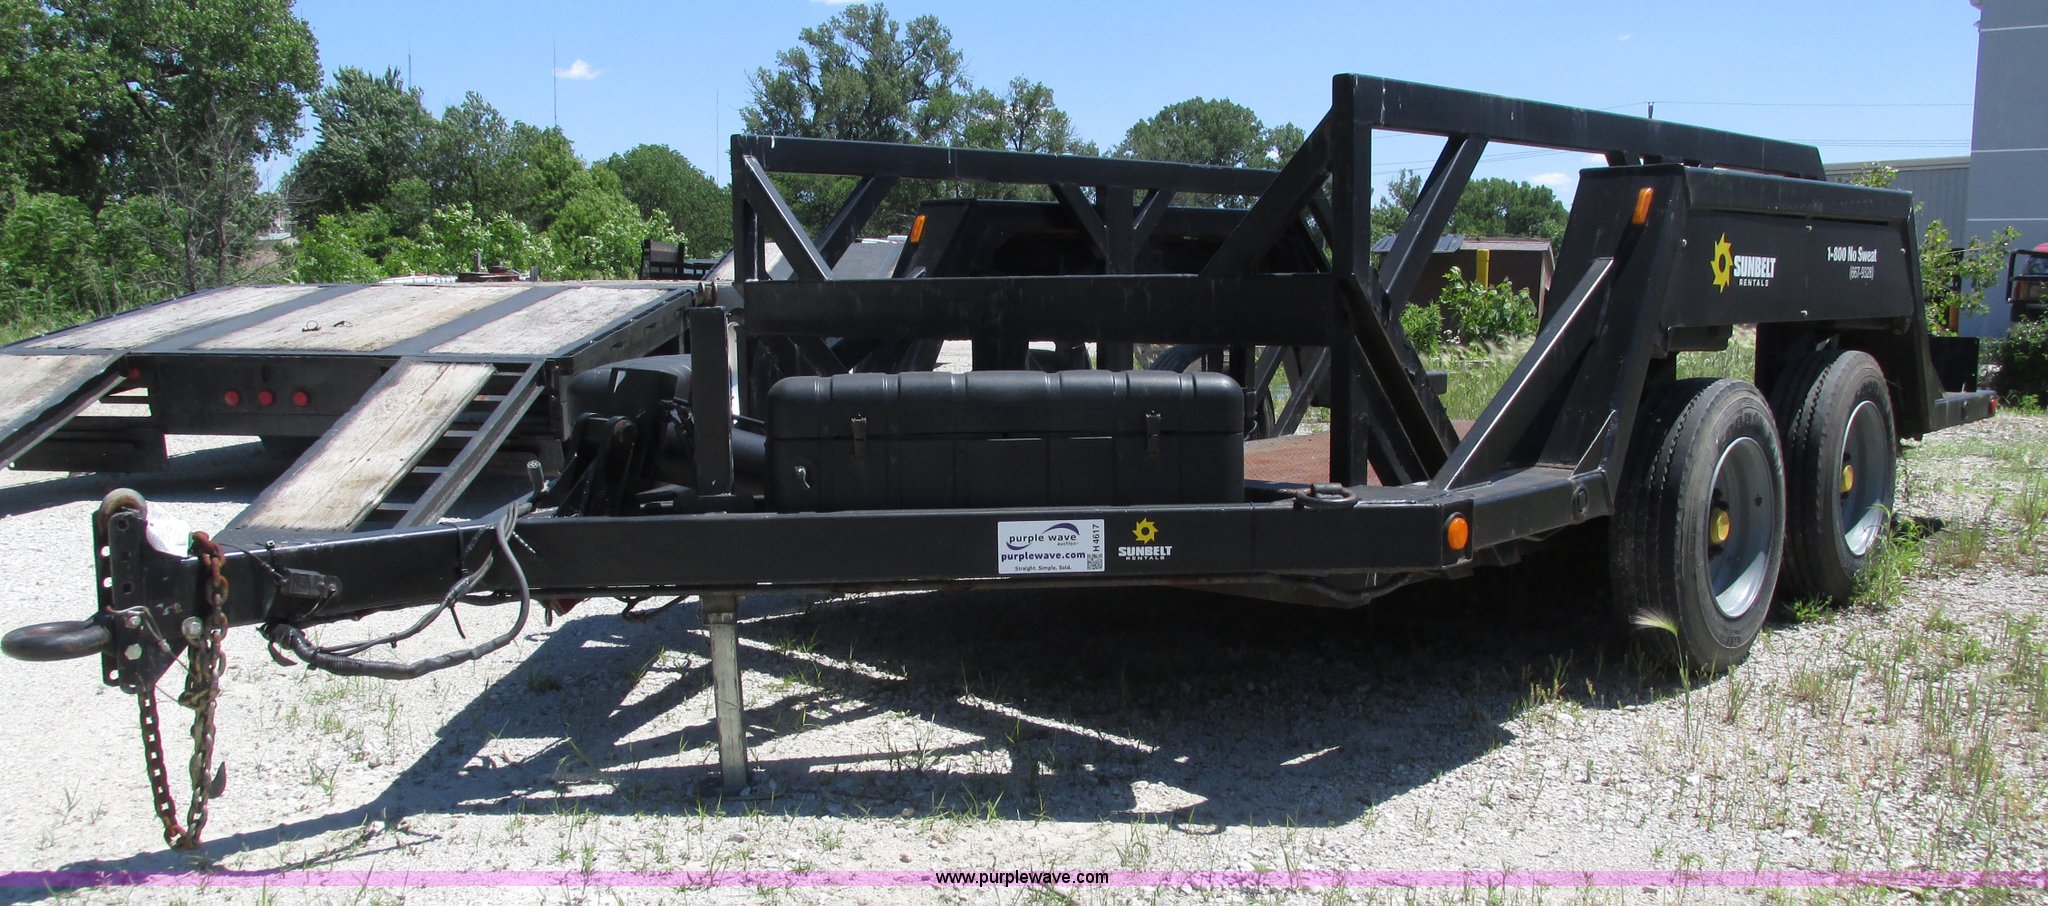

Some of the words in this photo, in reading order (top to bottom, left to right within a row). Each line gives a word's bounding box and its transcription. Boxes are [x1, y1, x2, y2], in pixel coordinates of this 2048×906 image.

[1827, 246, 1847, 262] 1-800
[1847, 246, 1857, 262] No
[1857, 246, 1877, 262] Sweat
[1733, 255, 1776, 278] SUNBELT
[1738, 278, 1769, 287] RENTALS
[1009, 533, 1044, 544] purple
[1001, 551, 1086, 562] purplewave.com
[1118, 545, 1173, 557] SUNBELT
